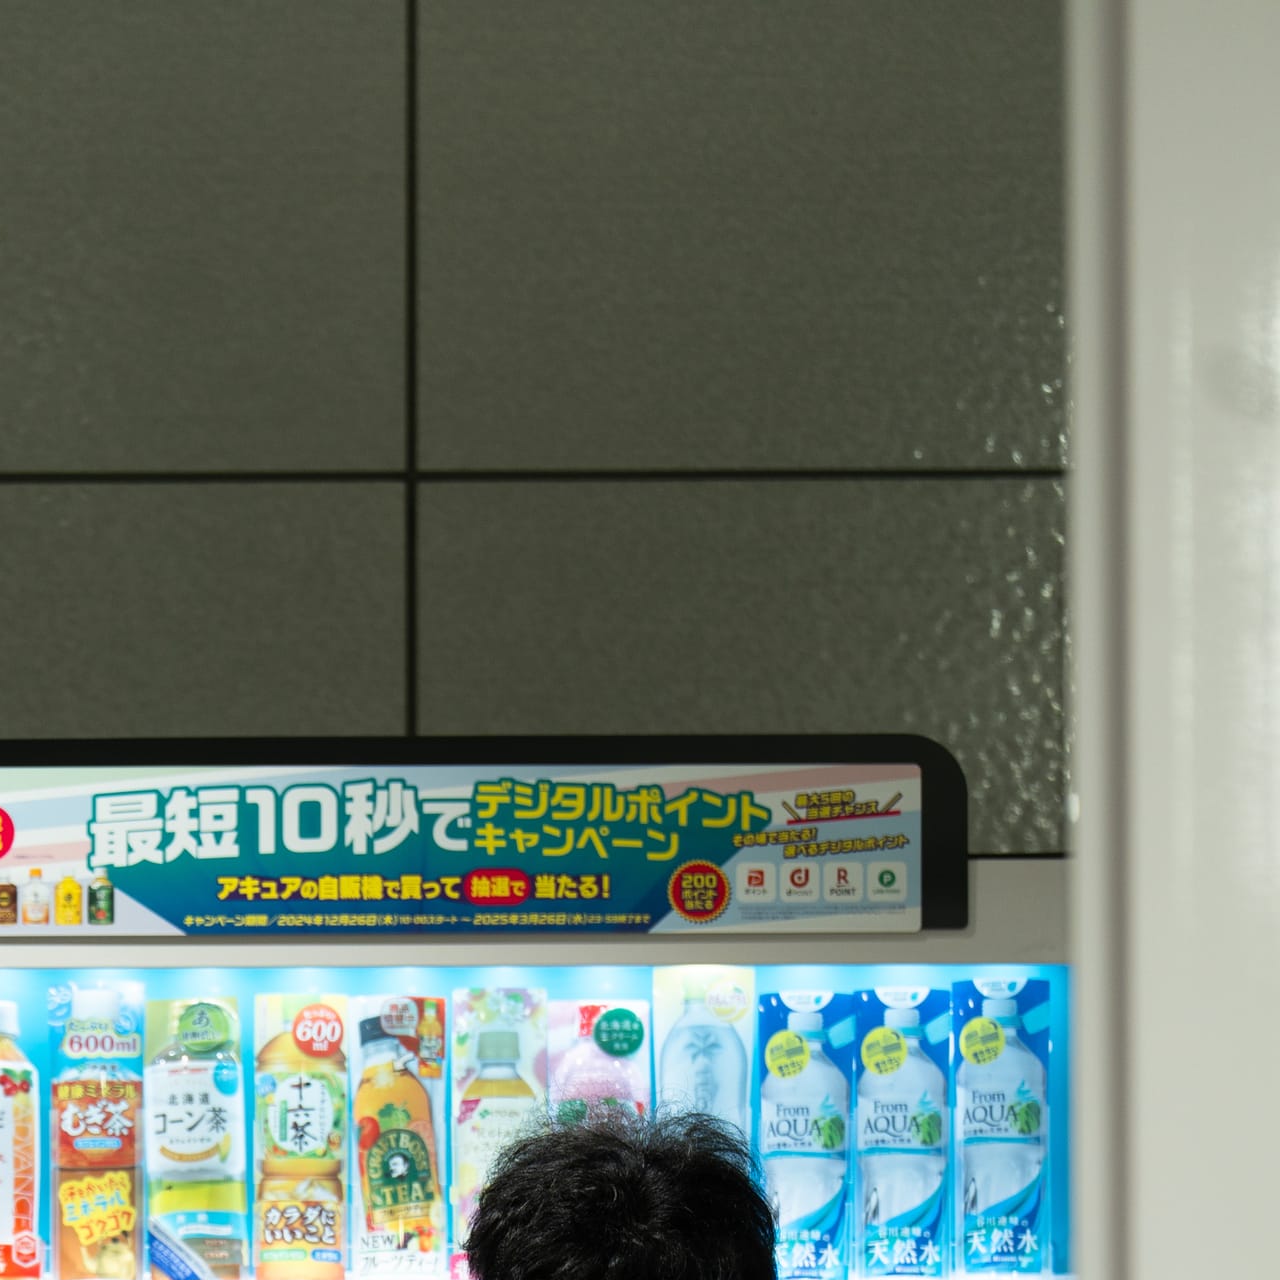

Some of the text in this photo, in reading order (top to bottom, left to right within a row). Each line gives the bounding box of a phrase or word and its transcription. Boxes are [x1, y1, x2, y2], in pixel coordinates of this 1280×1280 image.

[89, 780, 769, 869] 最短10秒で デジタルポイント
[474, 822, 679, 861] キャンペーン
[682, 873, 718, 888] 200
[830, 887, 856, 897] POINT
[69, 1033, 137, 1053] 600ml
[295, 1022, 341, 1043] 600
[312, 1041, 328, 1051] ml
[972, 1089, 1006, 1104] From
[61, 1100, 134, 1137] むぎ茶
[287, 1076, 317, 1152] 十六茶
[776, 1103, 810, 1118] From
[873, 1101, 909, 1116] From
[963, 1104, 1018, 1126] AQUA
[154, 1106, 228, 1135] コーン茶
[769, 1117, 822, 1140] AQUA
[864, 1115, 921, 1137] AQUA
[380, 1182, 423, 1206] TEA
[65, 1189, 126, 1222] ミネラル
[265, 1206, 335, 1226] カラダに
[79, 1209, 133, 1242] ゴクゴク
[264, 1225, 337, 1246] いいこと
[360, 1234, 395, 1250] NEW
[868, 1239, 941, 1267] 天然水
[967, 1229, 1039, 1255] 天然水
[776, 1242, 840, 1268] 天然水
